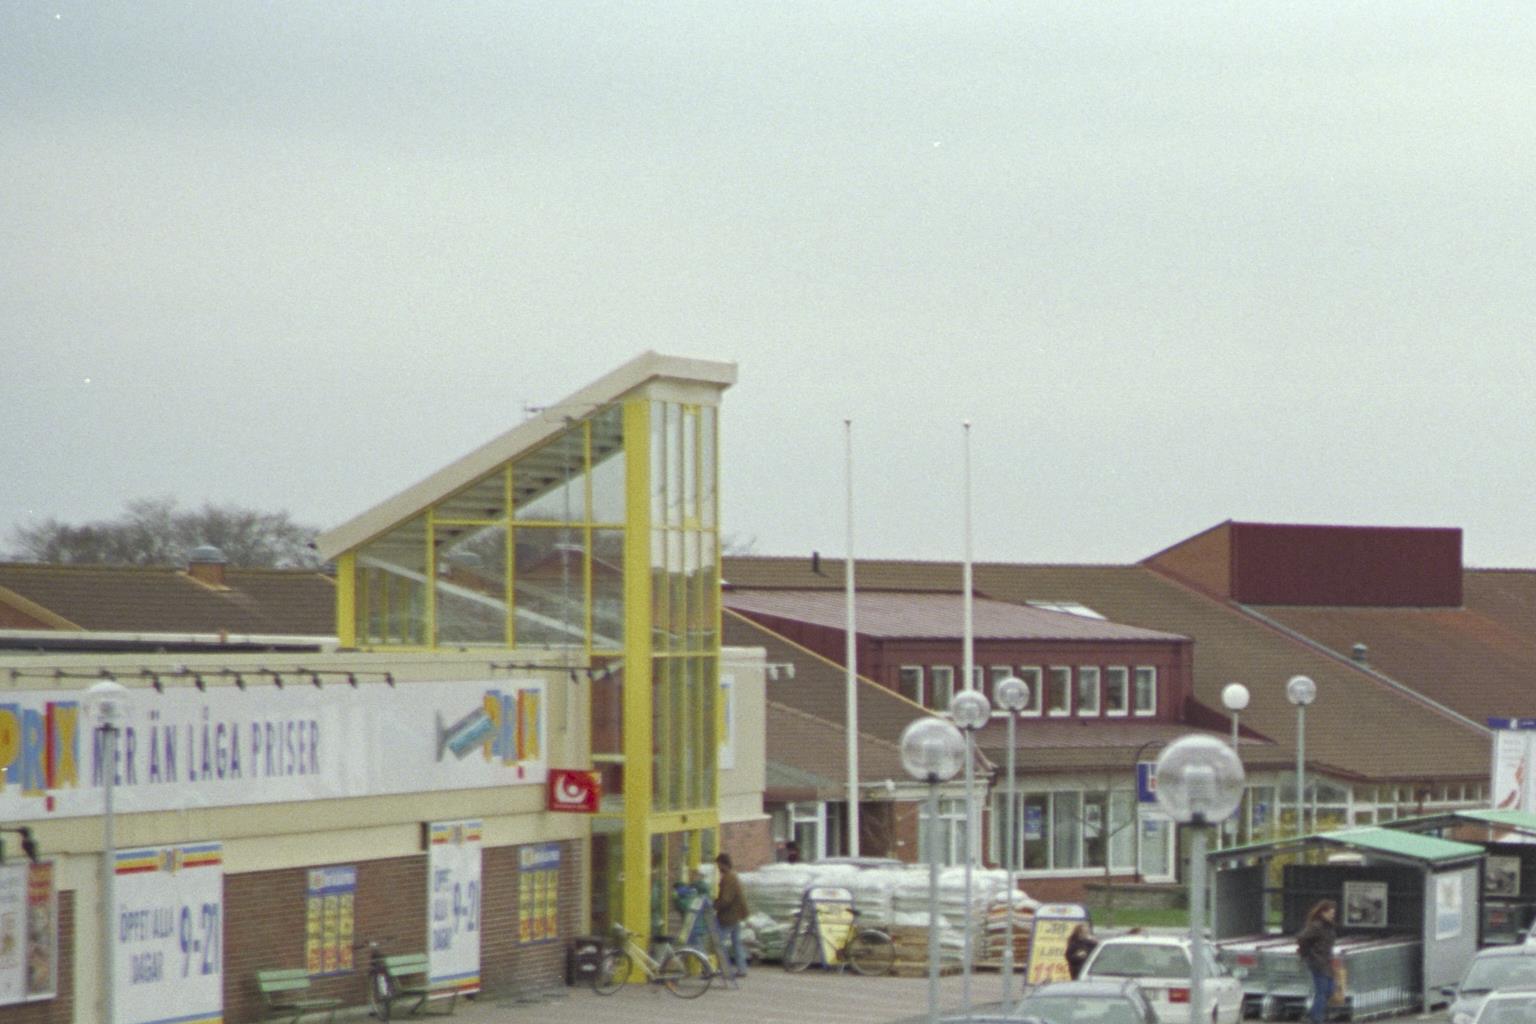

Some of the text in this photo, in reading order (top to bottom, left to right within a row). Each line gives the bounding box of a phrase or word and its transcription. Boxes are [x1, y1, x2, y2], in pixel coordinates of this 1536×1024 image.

[148, 708, 178, 784] ÄN
[188, 705, 242, 781] LÅGA
[251, 720, 320, 778] PRISER
